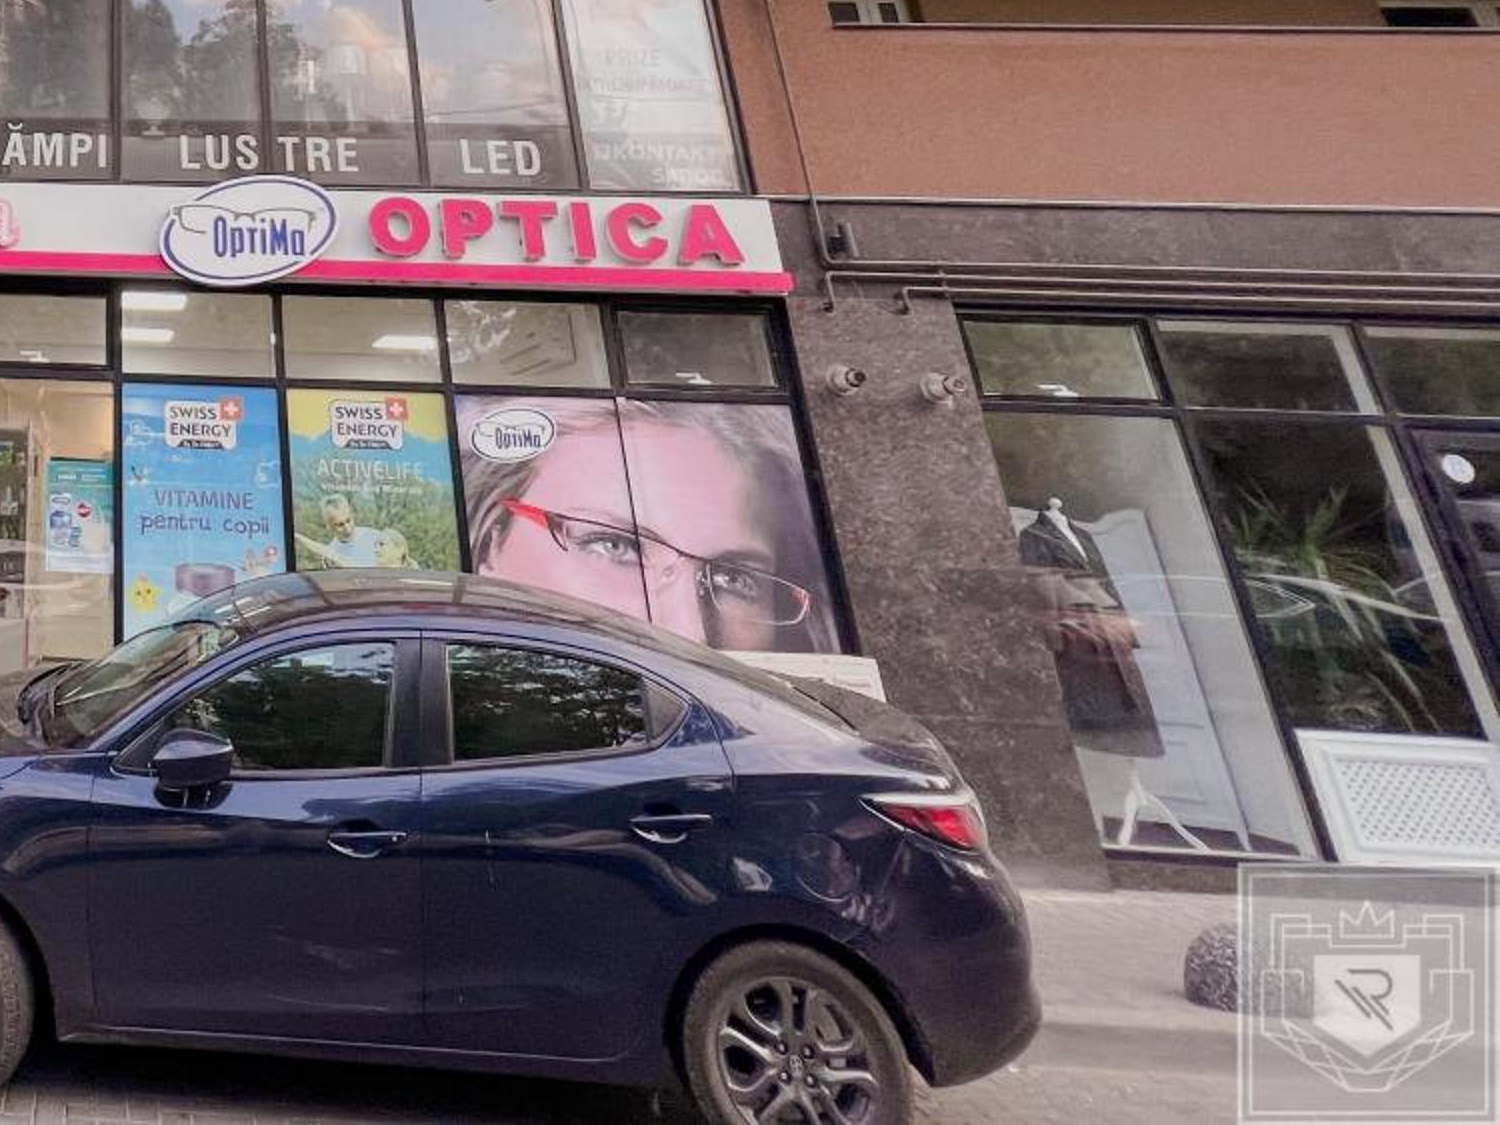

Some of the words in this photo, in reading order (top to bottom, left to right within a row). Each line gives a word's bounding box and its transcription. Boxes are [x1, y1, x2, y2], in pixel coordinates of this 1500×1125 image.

[460, 139, 541, 176] LED
[369, 196, 745, 265] OPTICA
[169, 406, 217, 419] SWISS
[335, 406, 383, 420] SWISS
[170, 423, 231, 437] ENERGY
[337, 423, 398, 438] ENERGY
[155, 490, 253, 510] VITAMINE
[140, 513, 212, 535] pentru
[223, 515, 269, 539] copii
